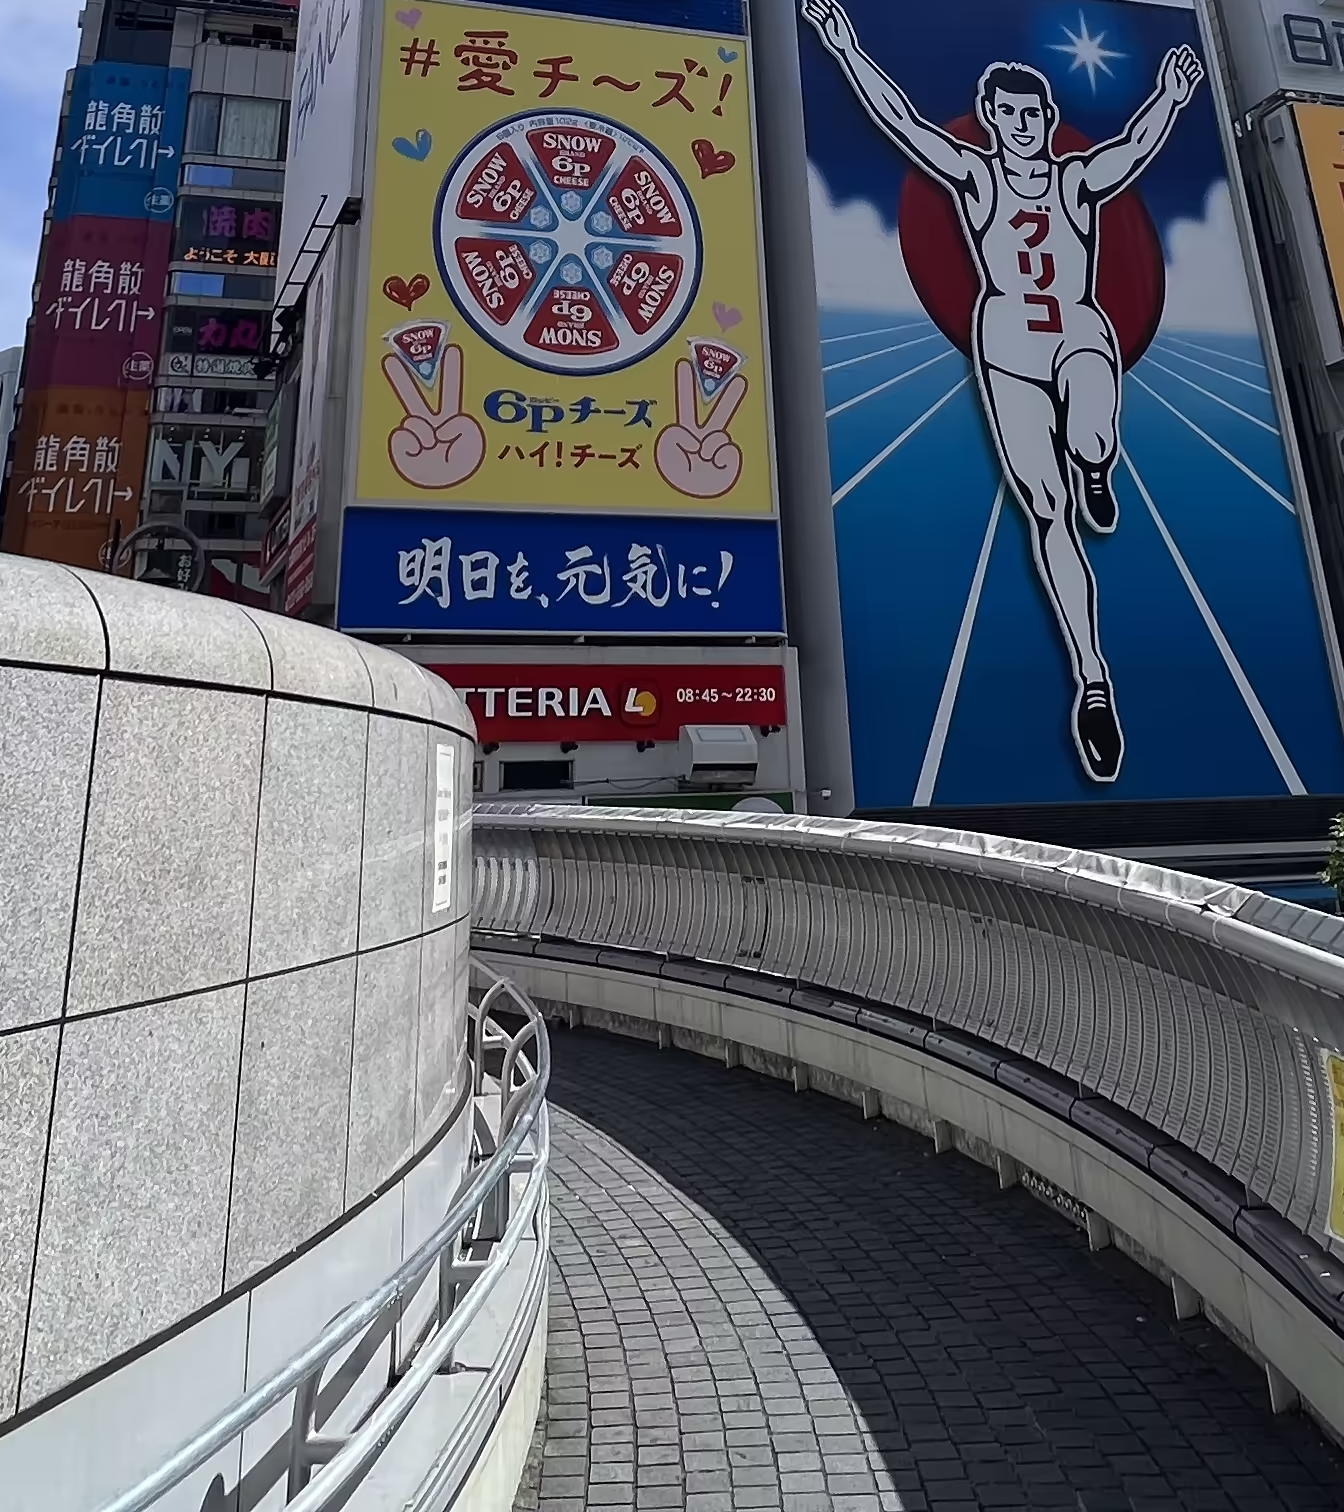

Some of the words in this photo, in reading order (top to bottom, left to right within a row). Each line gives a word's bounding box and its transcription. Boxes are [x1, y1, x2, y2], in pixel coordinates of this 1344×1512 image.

[84, 100, 166, 135] 龍角散
[71, 134, 157, 169] ダイレクト
[543, 133, 603, 153] SNOW
[466, 152, 508, 208] SNOW
[634, 170, 676, 225] SNOW
[60, 258, 145, 296] 龍角散
[462, 251, 505, 309] SNOW
[1008, 204, 1064, 334] グリコ
[638, 265, 675, 324] SNOW
[45, 296, 137, 333] ダイレクト
[539, 327, 603, 347] SNOW
[33, 435, 122, 473] 龍角散
[18, 476, 115, 514] ダイレクト
